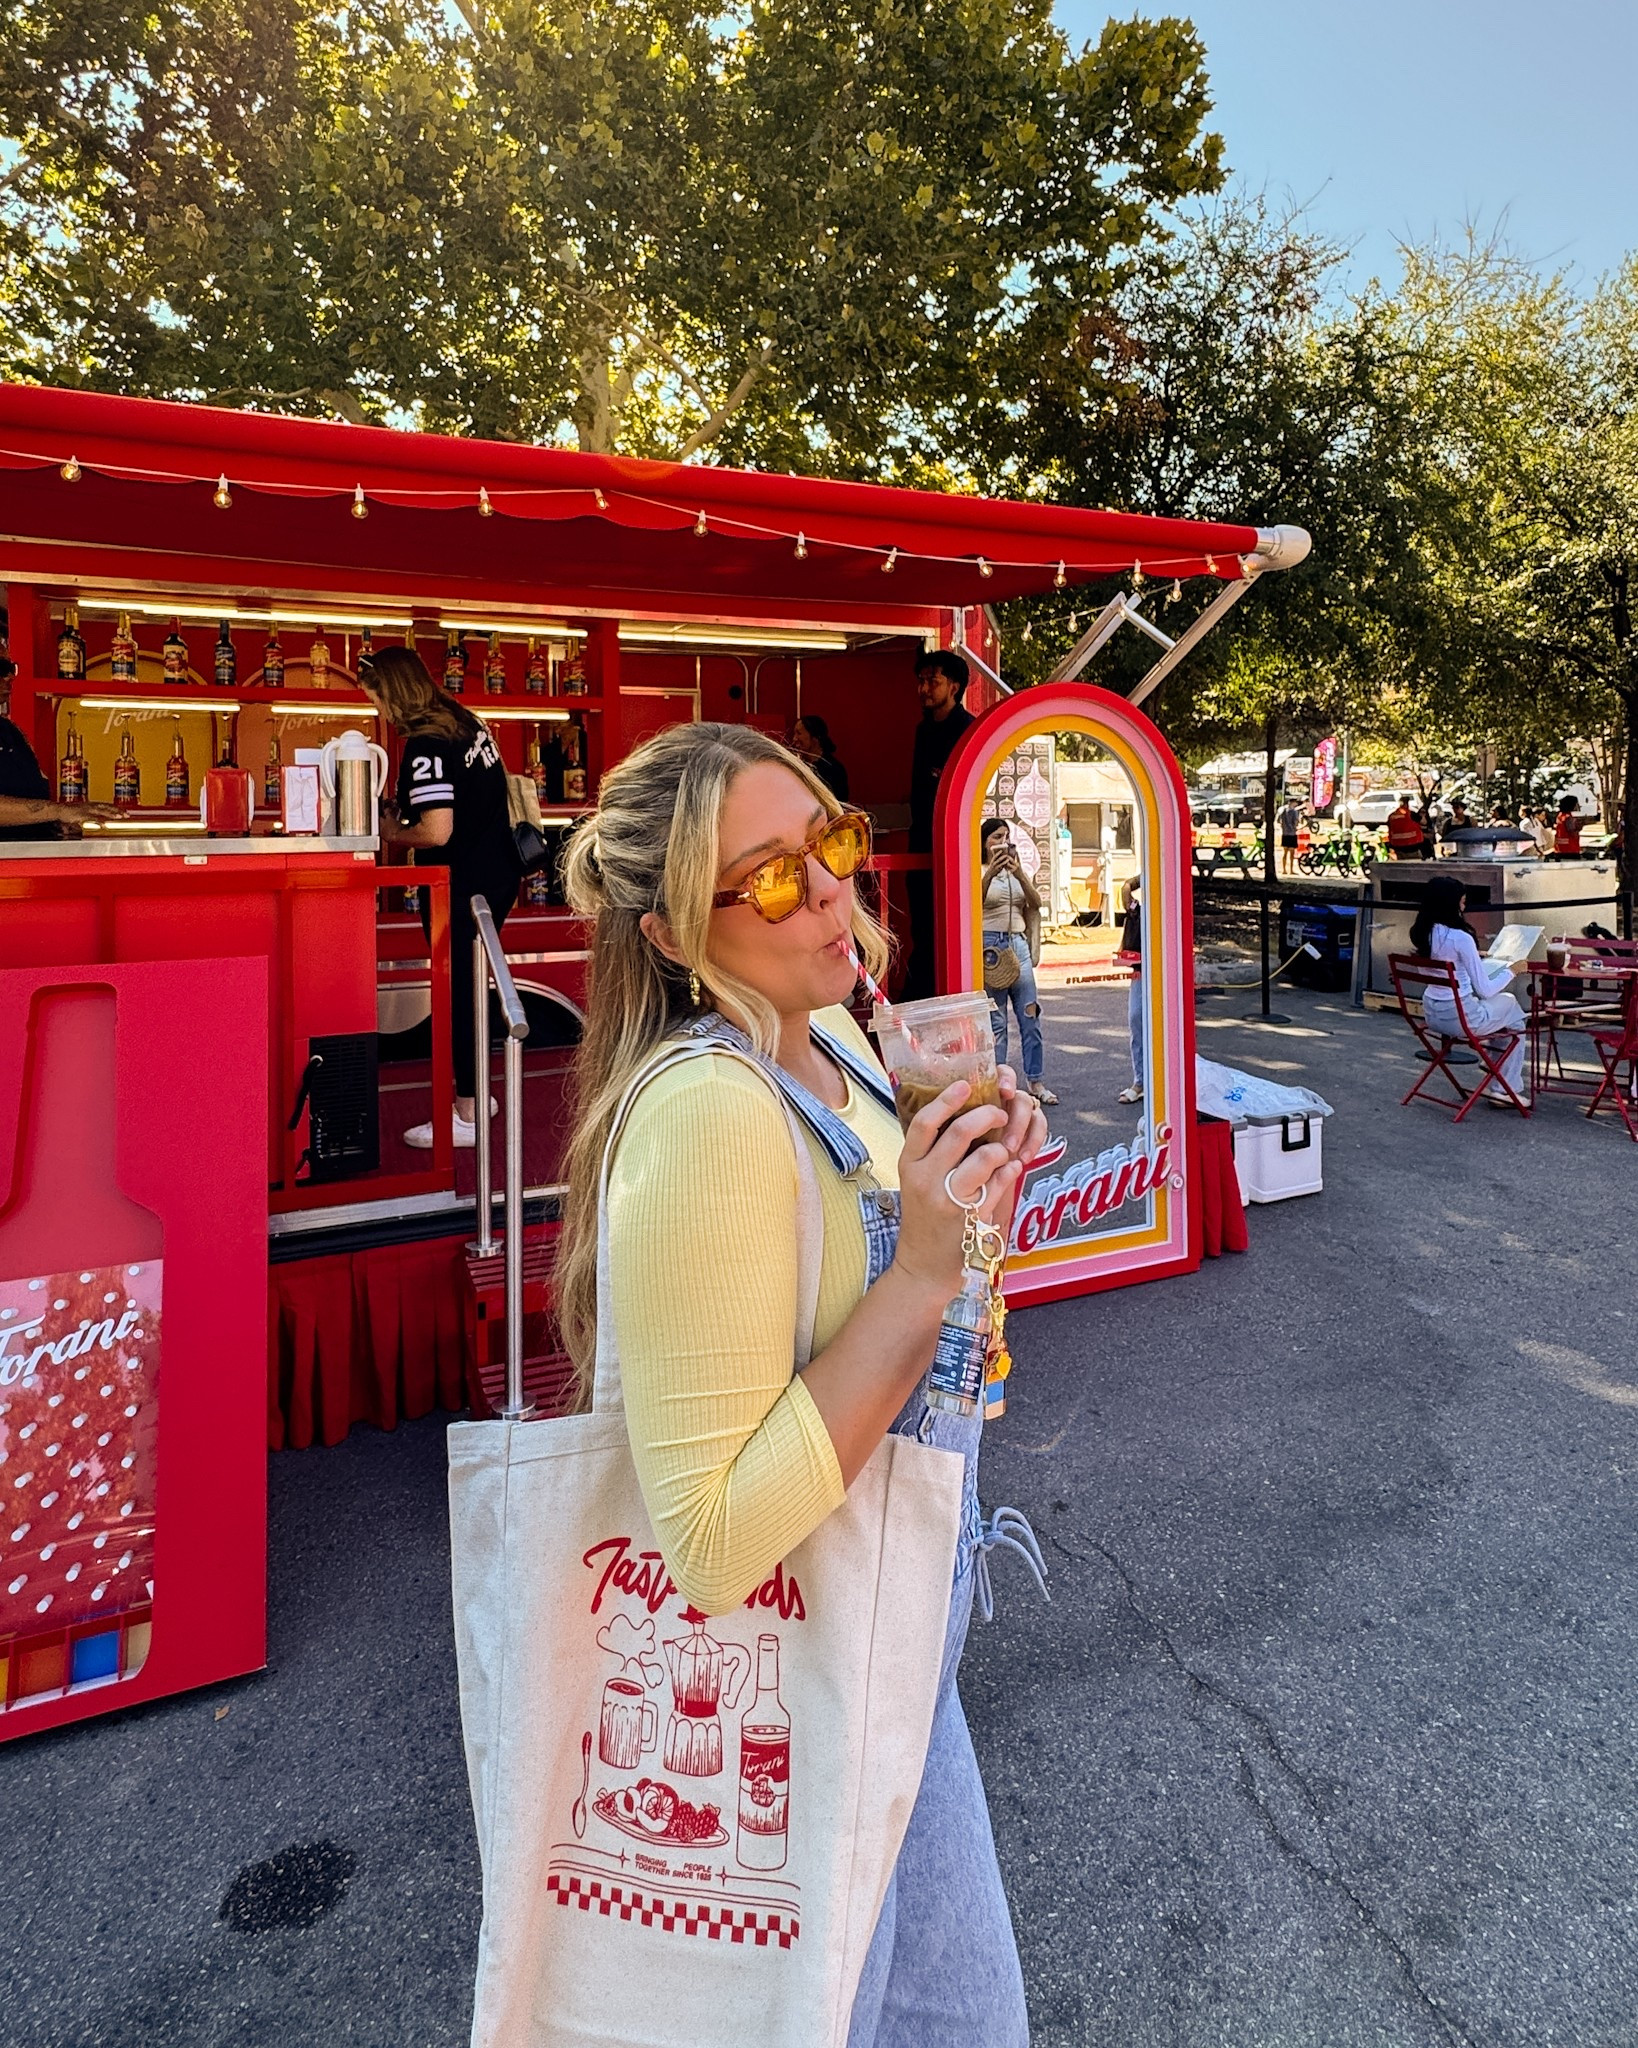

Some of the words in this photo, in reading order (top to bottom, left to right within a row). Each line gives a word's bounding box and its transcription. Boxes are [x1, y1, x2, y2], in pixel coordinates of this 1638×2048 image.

[412, 756, 443, 781] 21
[741, 1748, 787, 1776] Torani
[635, 1853, 668, 1867] BRINGING
[683, 1862, 712, 1873] PEOPLE
[635, 1861, 671, 1876] TOGETHER
